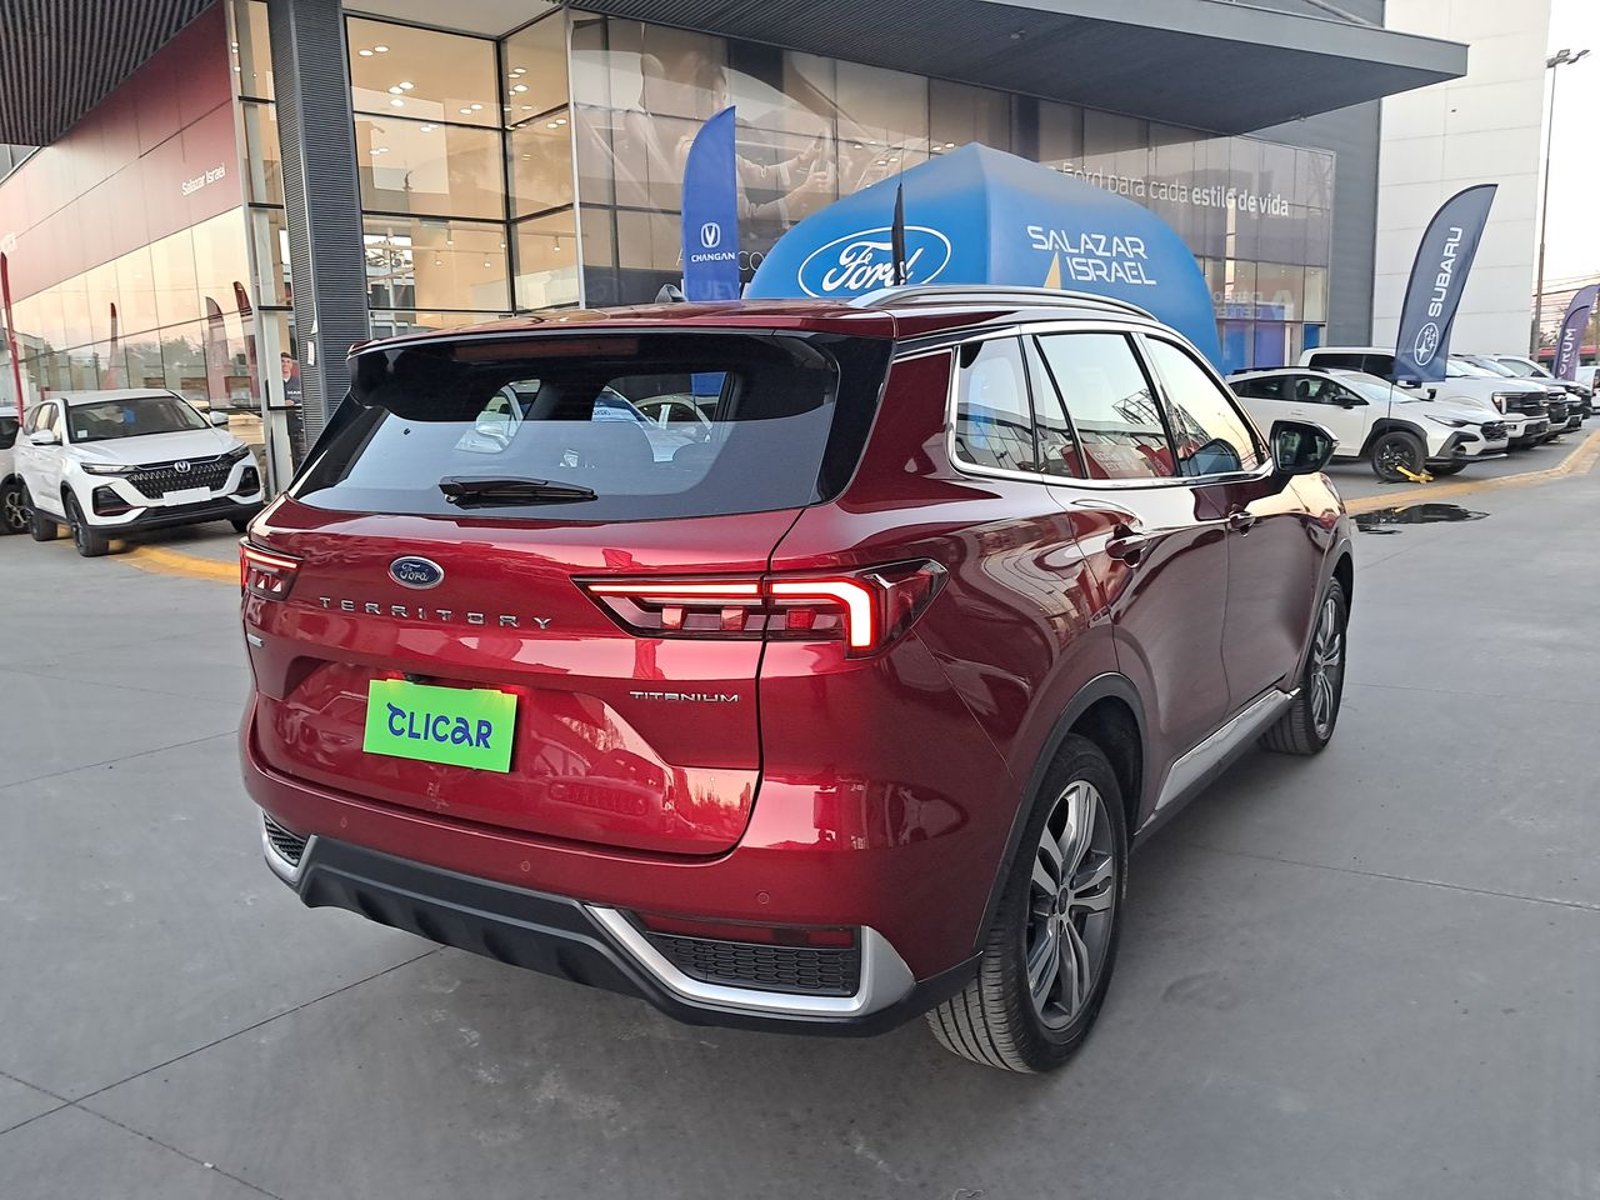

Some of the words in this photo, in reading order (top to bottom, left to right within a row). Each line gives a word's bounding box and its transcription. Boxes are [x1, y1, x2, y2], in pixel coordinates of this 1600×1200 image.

[1150, 176, 1188, 203] cada
[1191, 185, 1236, 209] estilo
[1238, 189, 1256, 212] de
[1258, 194, 1289, 217] vida
[690, 252, 736, 263] CHANGAN
[1026, 225, 1148, 260] SALAZAR
[1066, 256, 1157, 285] ISRAEL
[1428, 227, 1463, 318] SUBARU
[1558, 328, 1577, 379] ORUM
[399, 562, 430, 582] Ford
[319, 597, 552, 630] TERRITORY
[629, 691, 739, 702] TITANIUM
